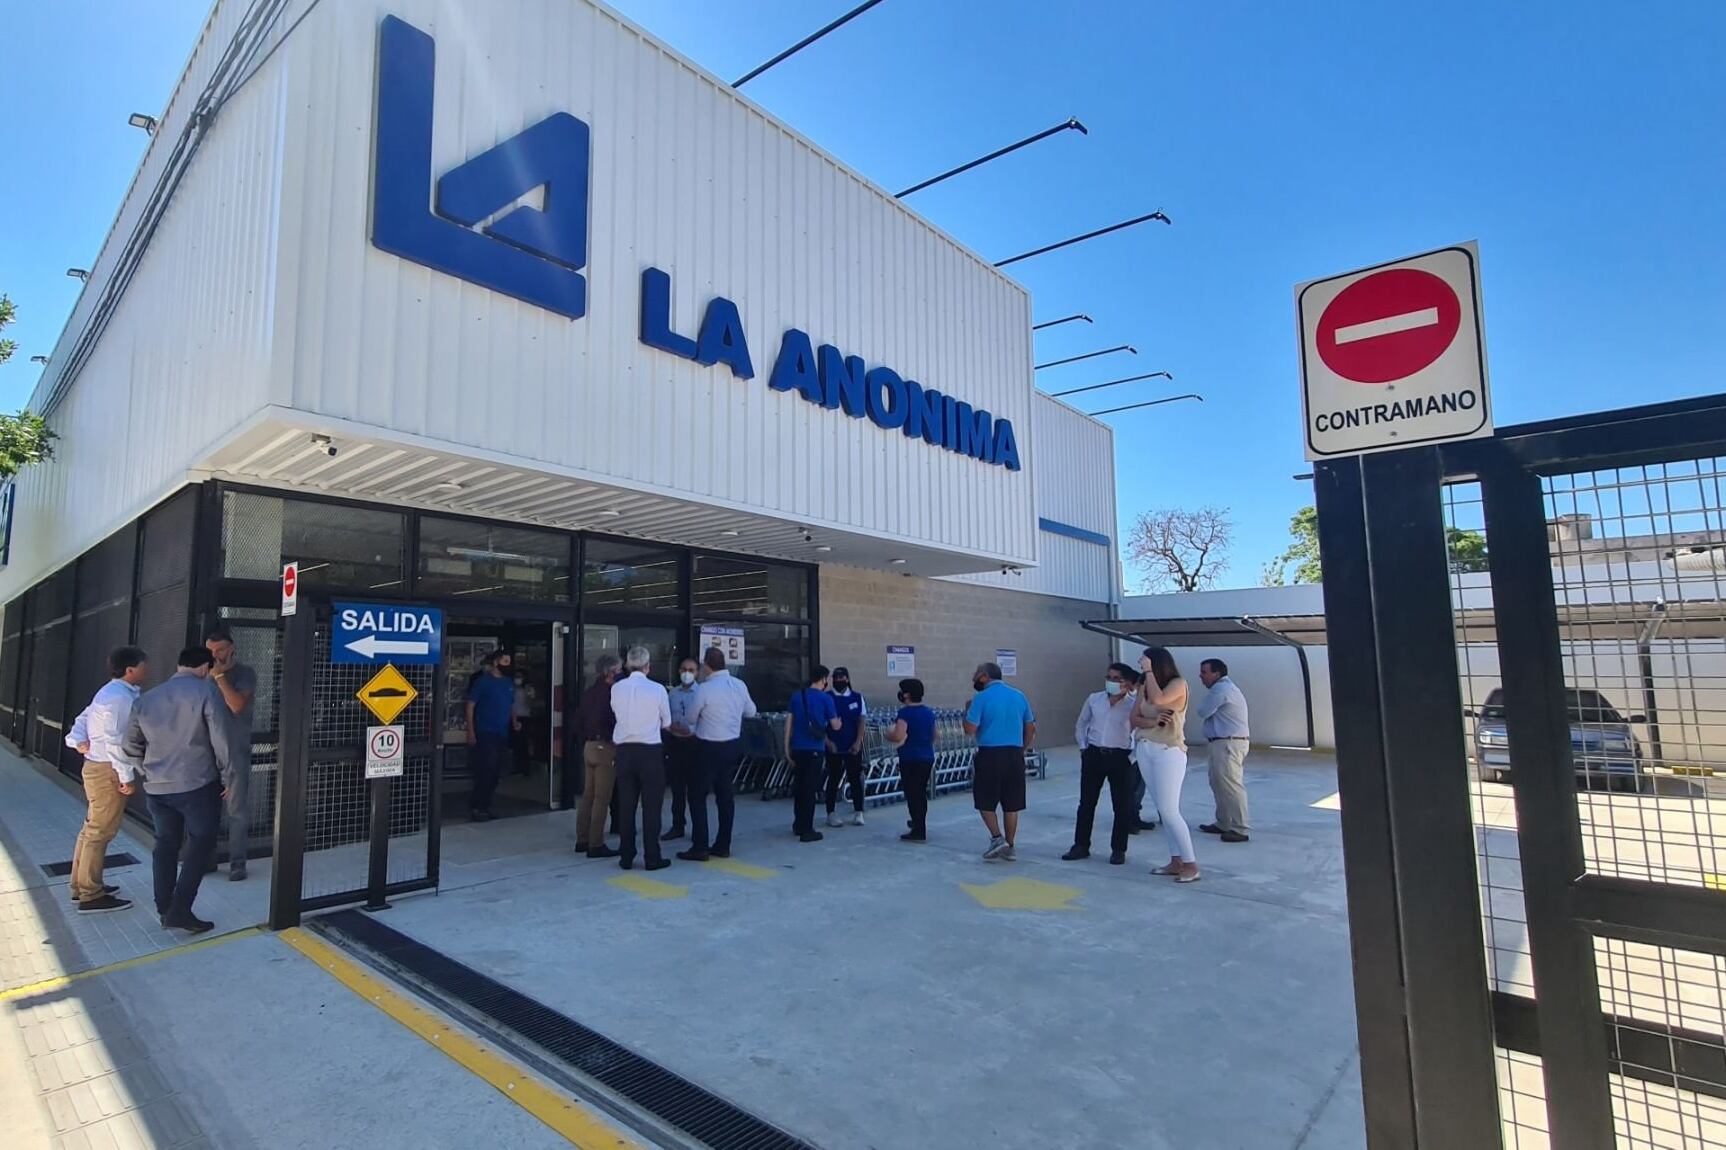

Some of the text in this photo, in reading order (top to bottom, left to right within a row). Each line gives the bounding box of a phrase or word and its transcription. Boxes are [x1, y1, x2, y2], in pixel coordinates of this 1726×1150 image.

[638, 266, 1021, 472] LA ANONIMA
[1315, 390, 1476, 432] CONTRAMANO
[341, 609, 435, 633] SALIDA
[378, 734, 395, 747] 10
